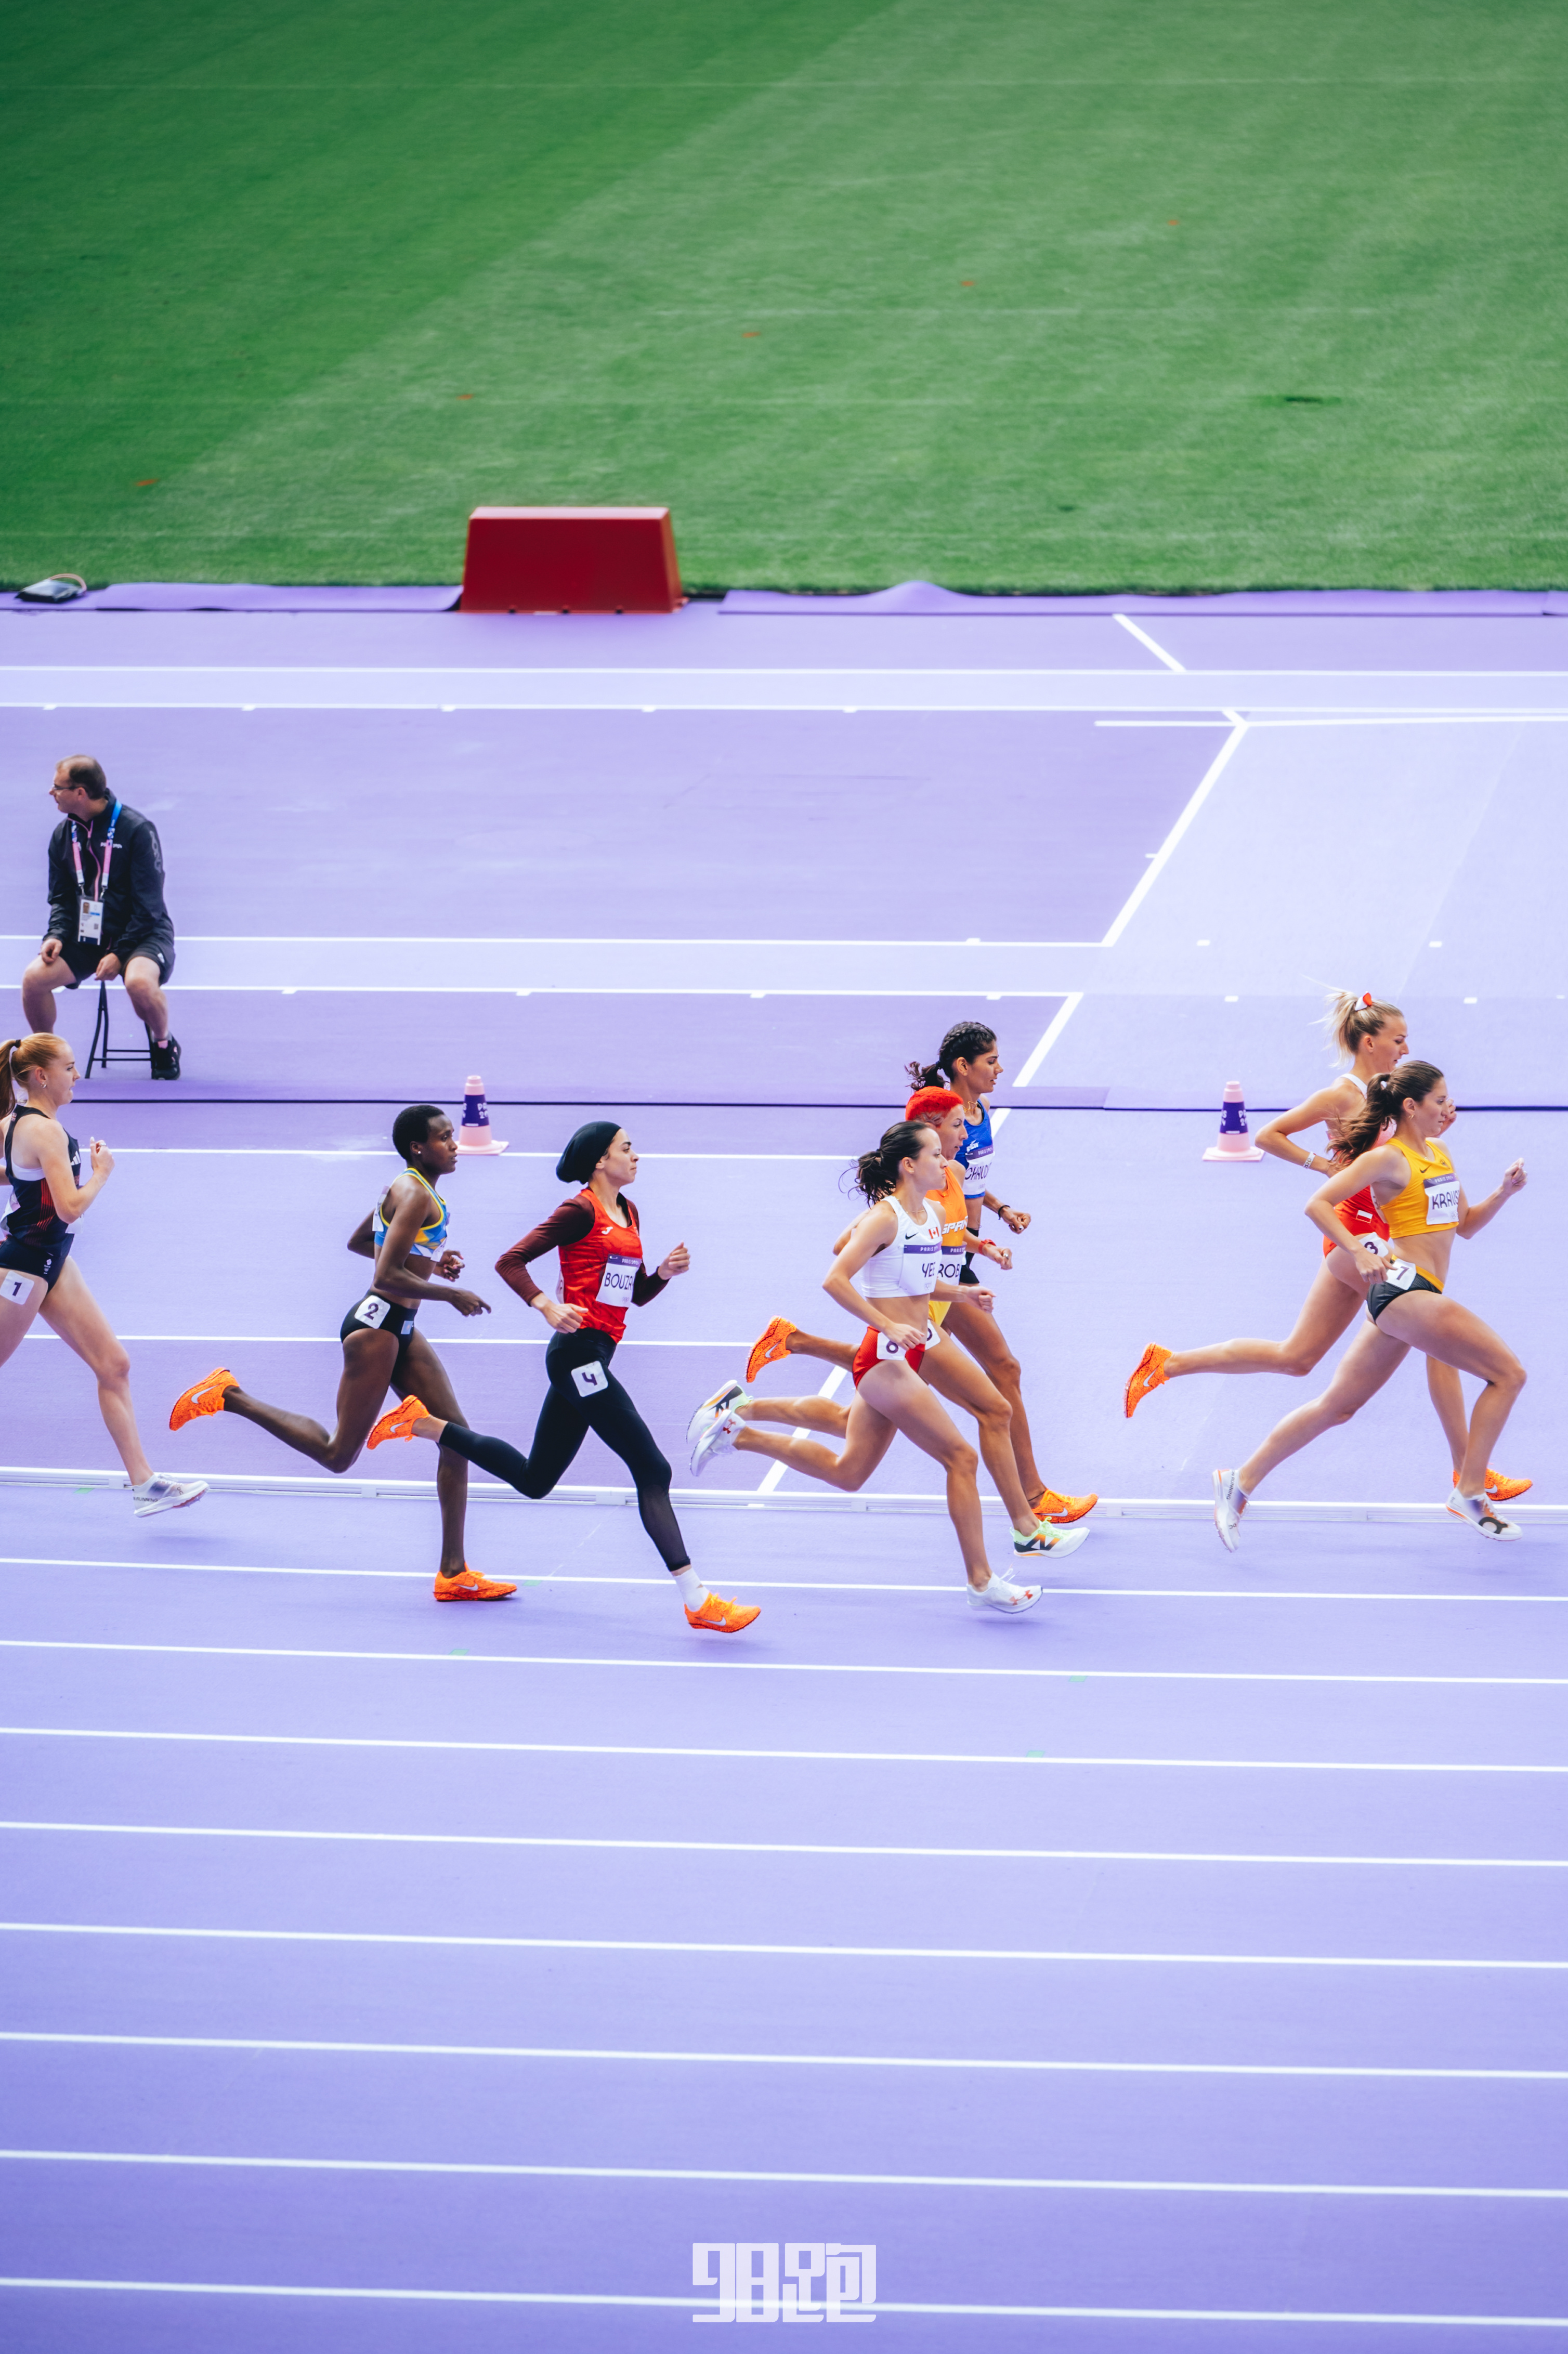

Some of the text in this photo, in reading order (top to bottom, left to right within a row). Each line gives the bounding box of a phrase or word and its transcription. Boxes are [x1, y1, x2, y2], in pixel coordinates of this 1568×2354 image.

[965, 1162, 992, 1180] CHAUD
[1432, 1189, 1459, 1210] KRAUS
[1364, 1241, 1378, 1254] 3
[604, 1272, 634, 1290] BOUZA
[1396, 1266, 1409, 1280] 7
[12, 1281, 22, 1297] 1
[364, 1303, 379, 1320] 2
[582, 1372, 598, 1386] 4
